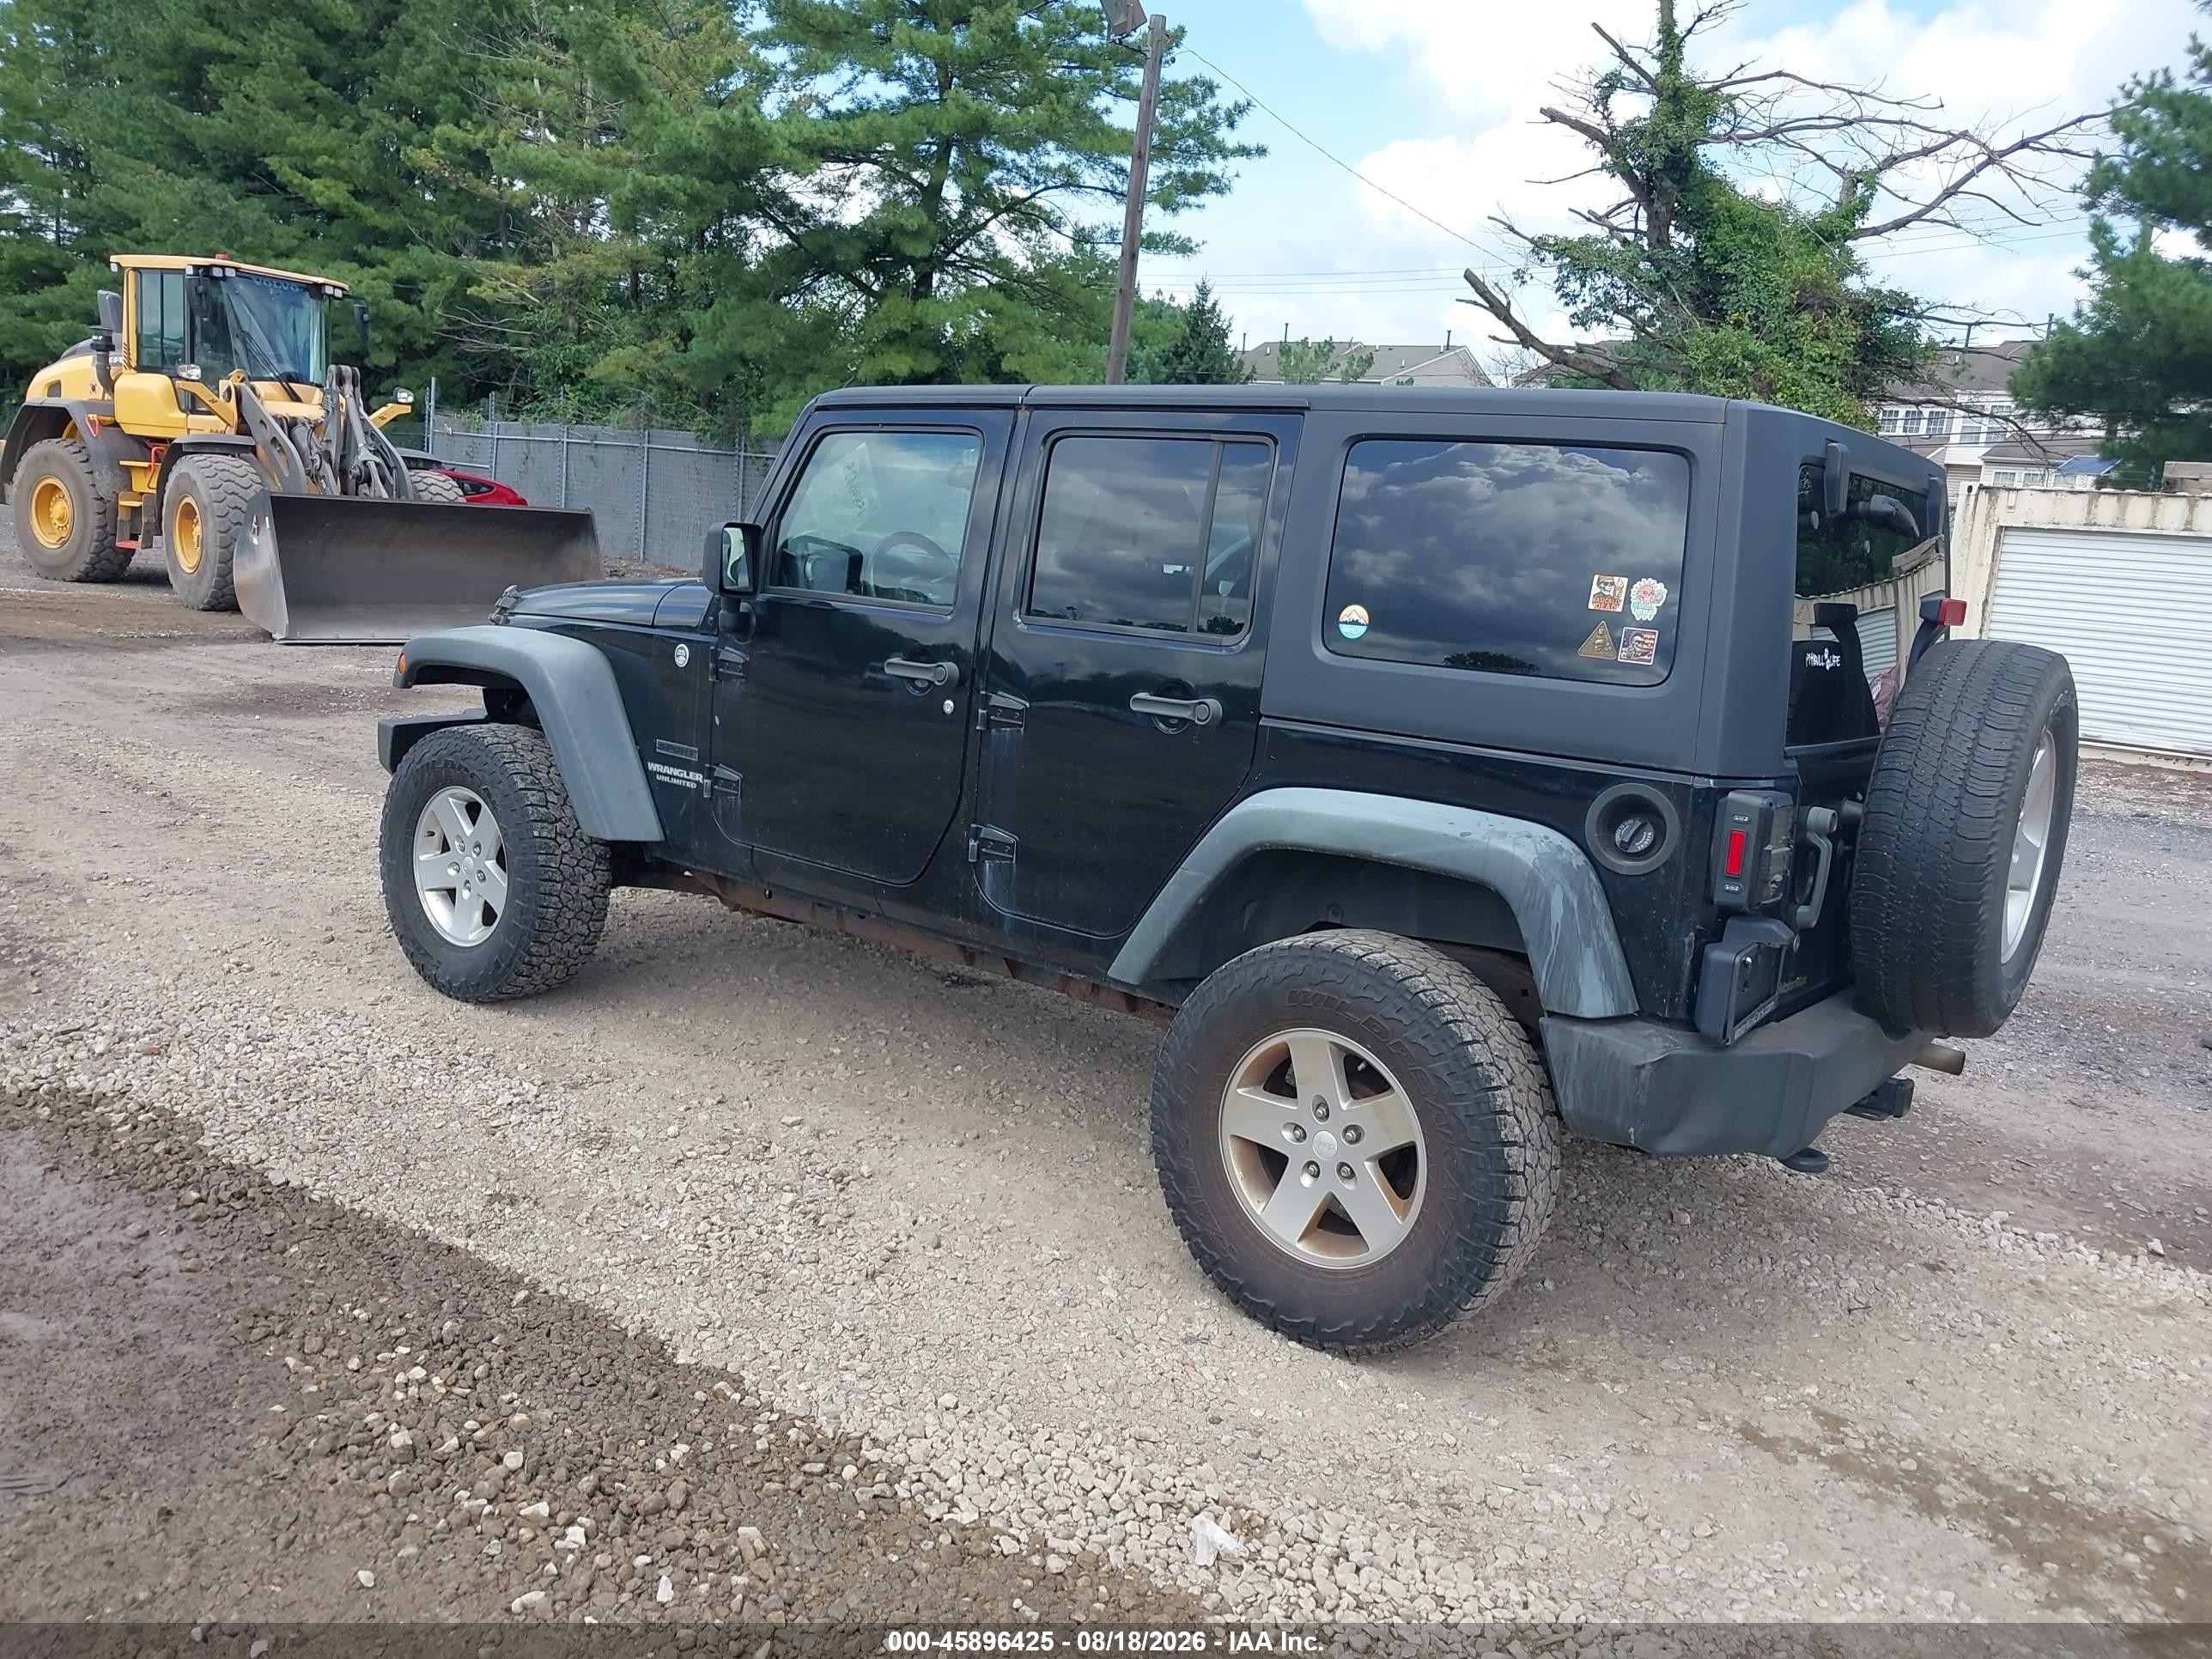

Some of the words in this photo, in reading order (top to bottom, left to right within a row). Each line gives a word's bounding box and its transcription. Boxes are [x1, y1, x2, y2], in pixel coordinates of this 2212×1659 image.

[253, 278, 299, 292] VOLVO
[647, 762, 704, 784] WRANGLER
[656, 774, 697, 789] UNLIMITED
